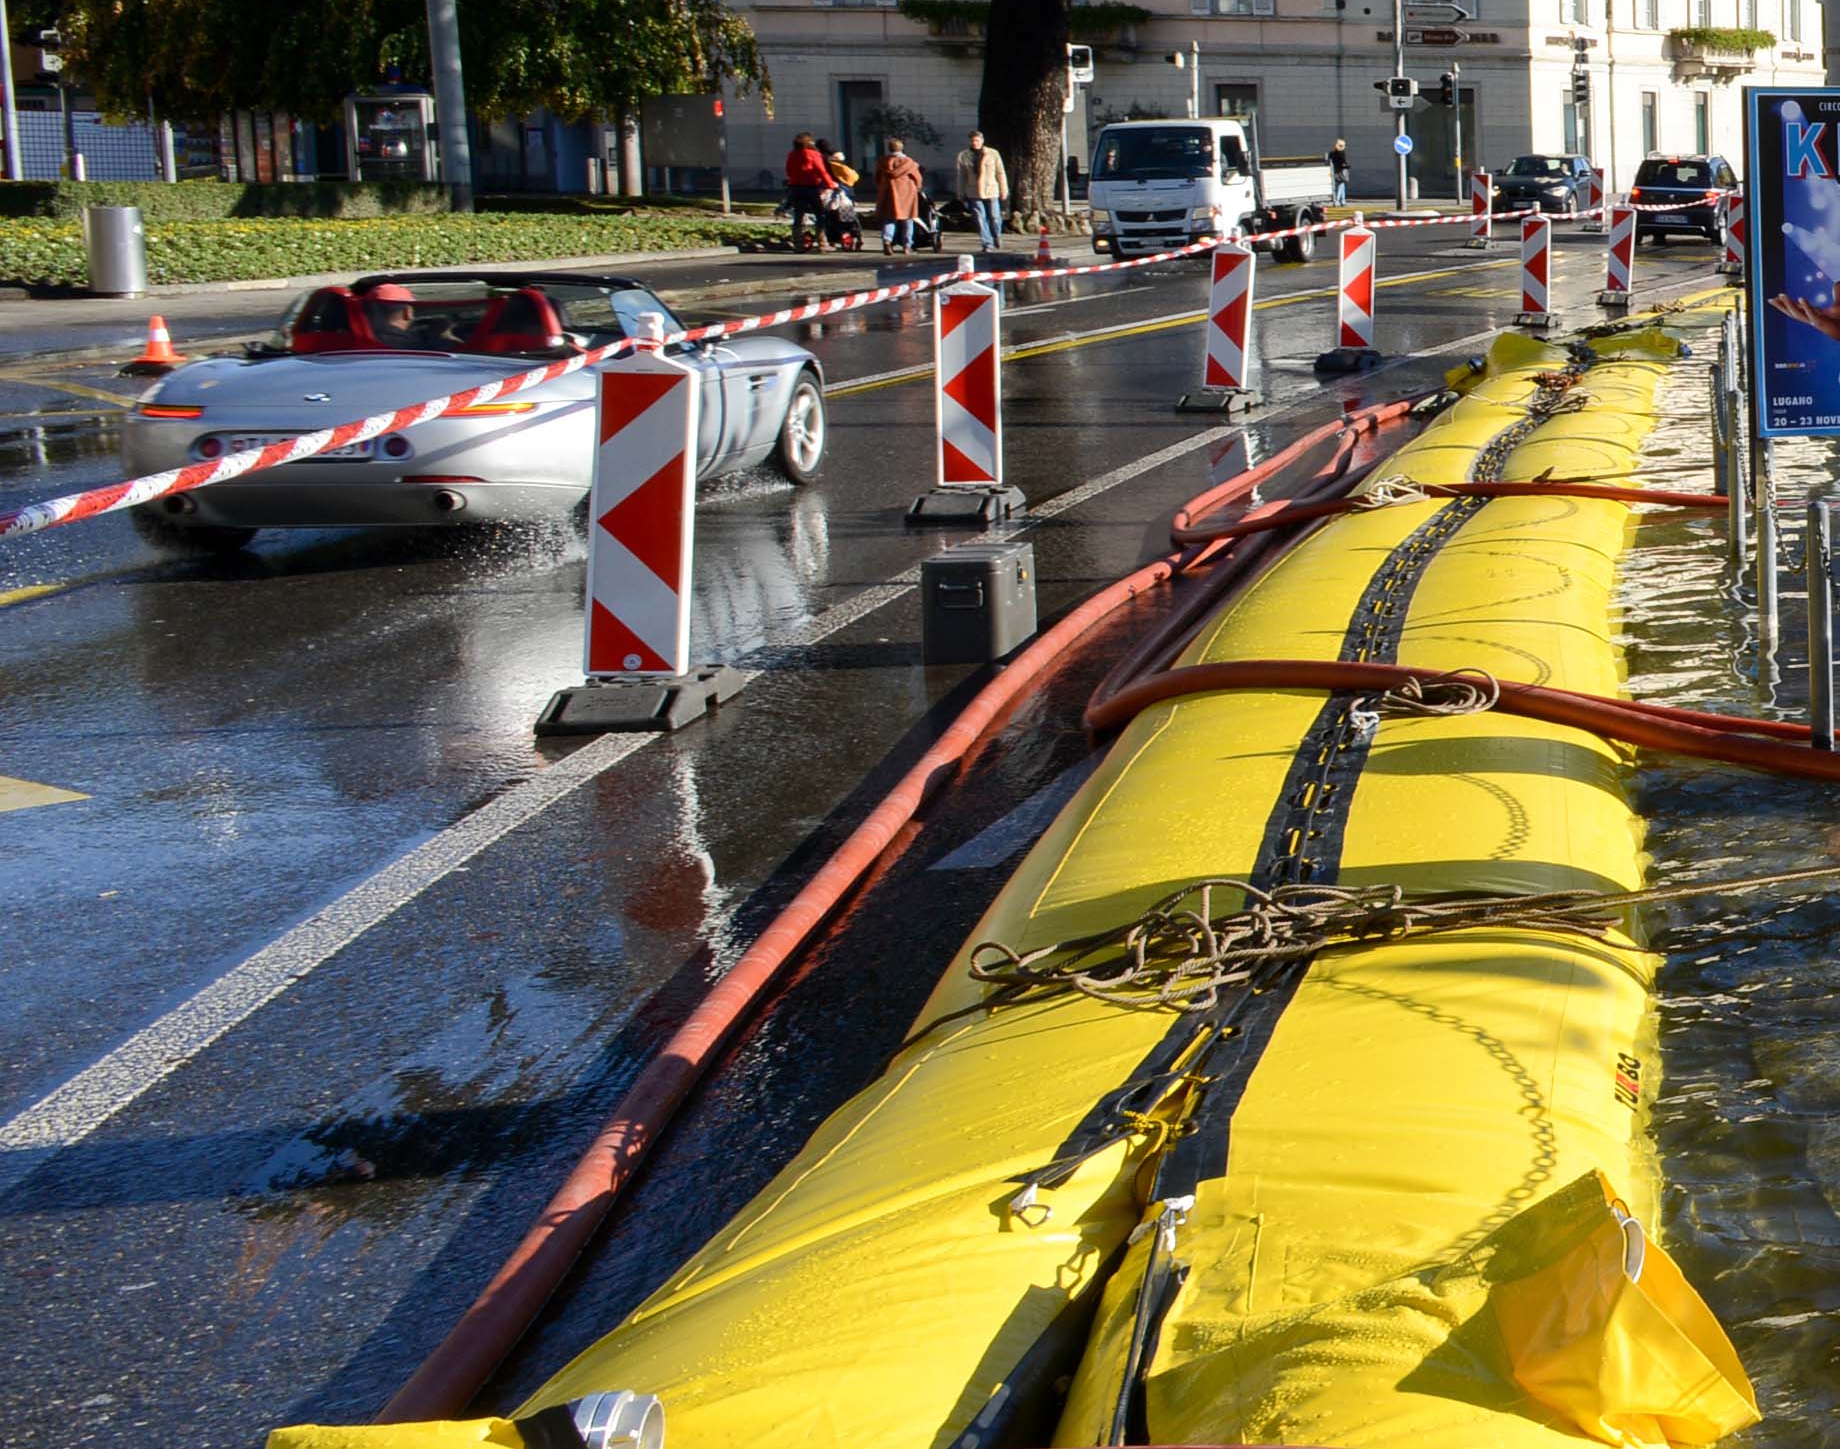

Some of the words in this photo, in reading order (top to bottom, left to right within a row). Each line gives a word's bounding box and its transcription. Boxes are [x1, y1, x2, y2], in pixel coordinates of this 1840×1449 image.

[1773, 396, 1813, 406] LUGANO
[1774, 417, 1787, 426] 20
[1800, 416, 1812, 425] 23
[1614, 1052, 1641, 1113] TURBO
